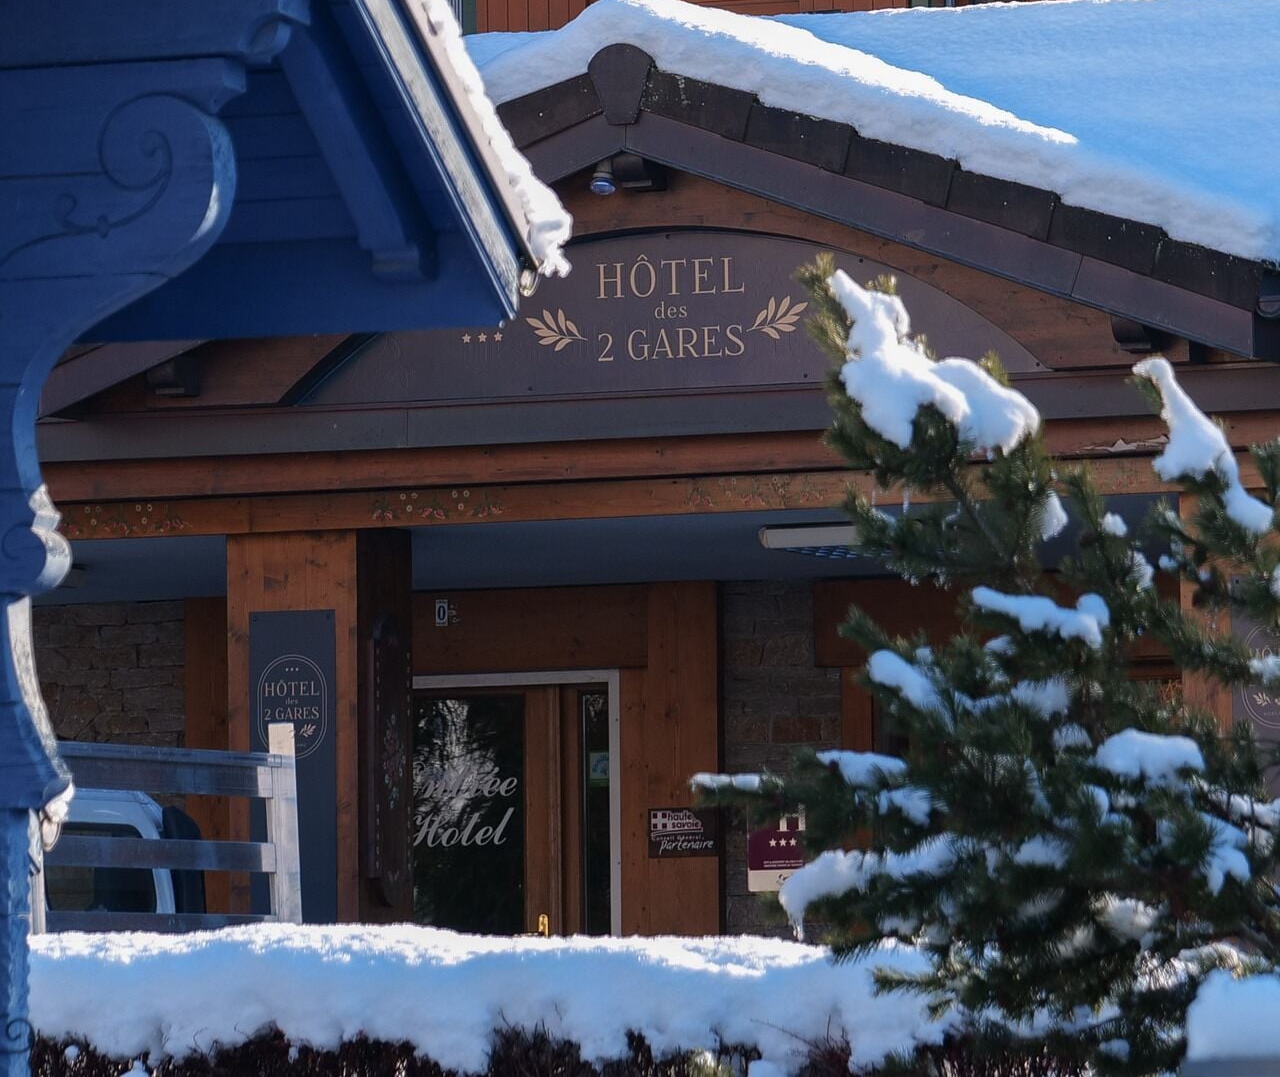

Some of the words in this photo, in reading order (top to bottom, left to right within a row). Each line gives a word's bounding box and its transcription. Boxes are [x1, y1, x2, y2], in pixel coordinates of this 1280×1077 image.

[596, 254, 745, 299] HÔTEL
[654, 301, 688, 320] des
[598, 333, 614, 362] 2
[628, 324, 745, 360] GARES
[264, 679, 320, 697] HÔTEL
[285, 697, 299, 705] des
[264, 709, 271, 720] 2
[275, 707, 320, 720] GARES
